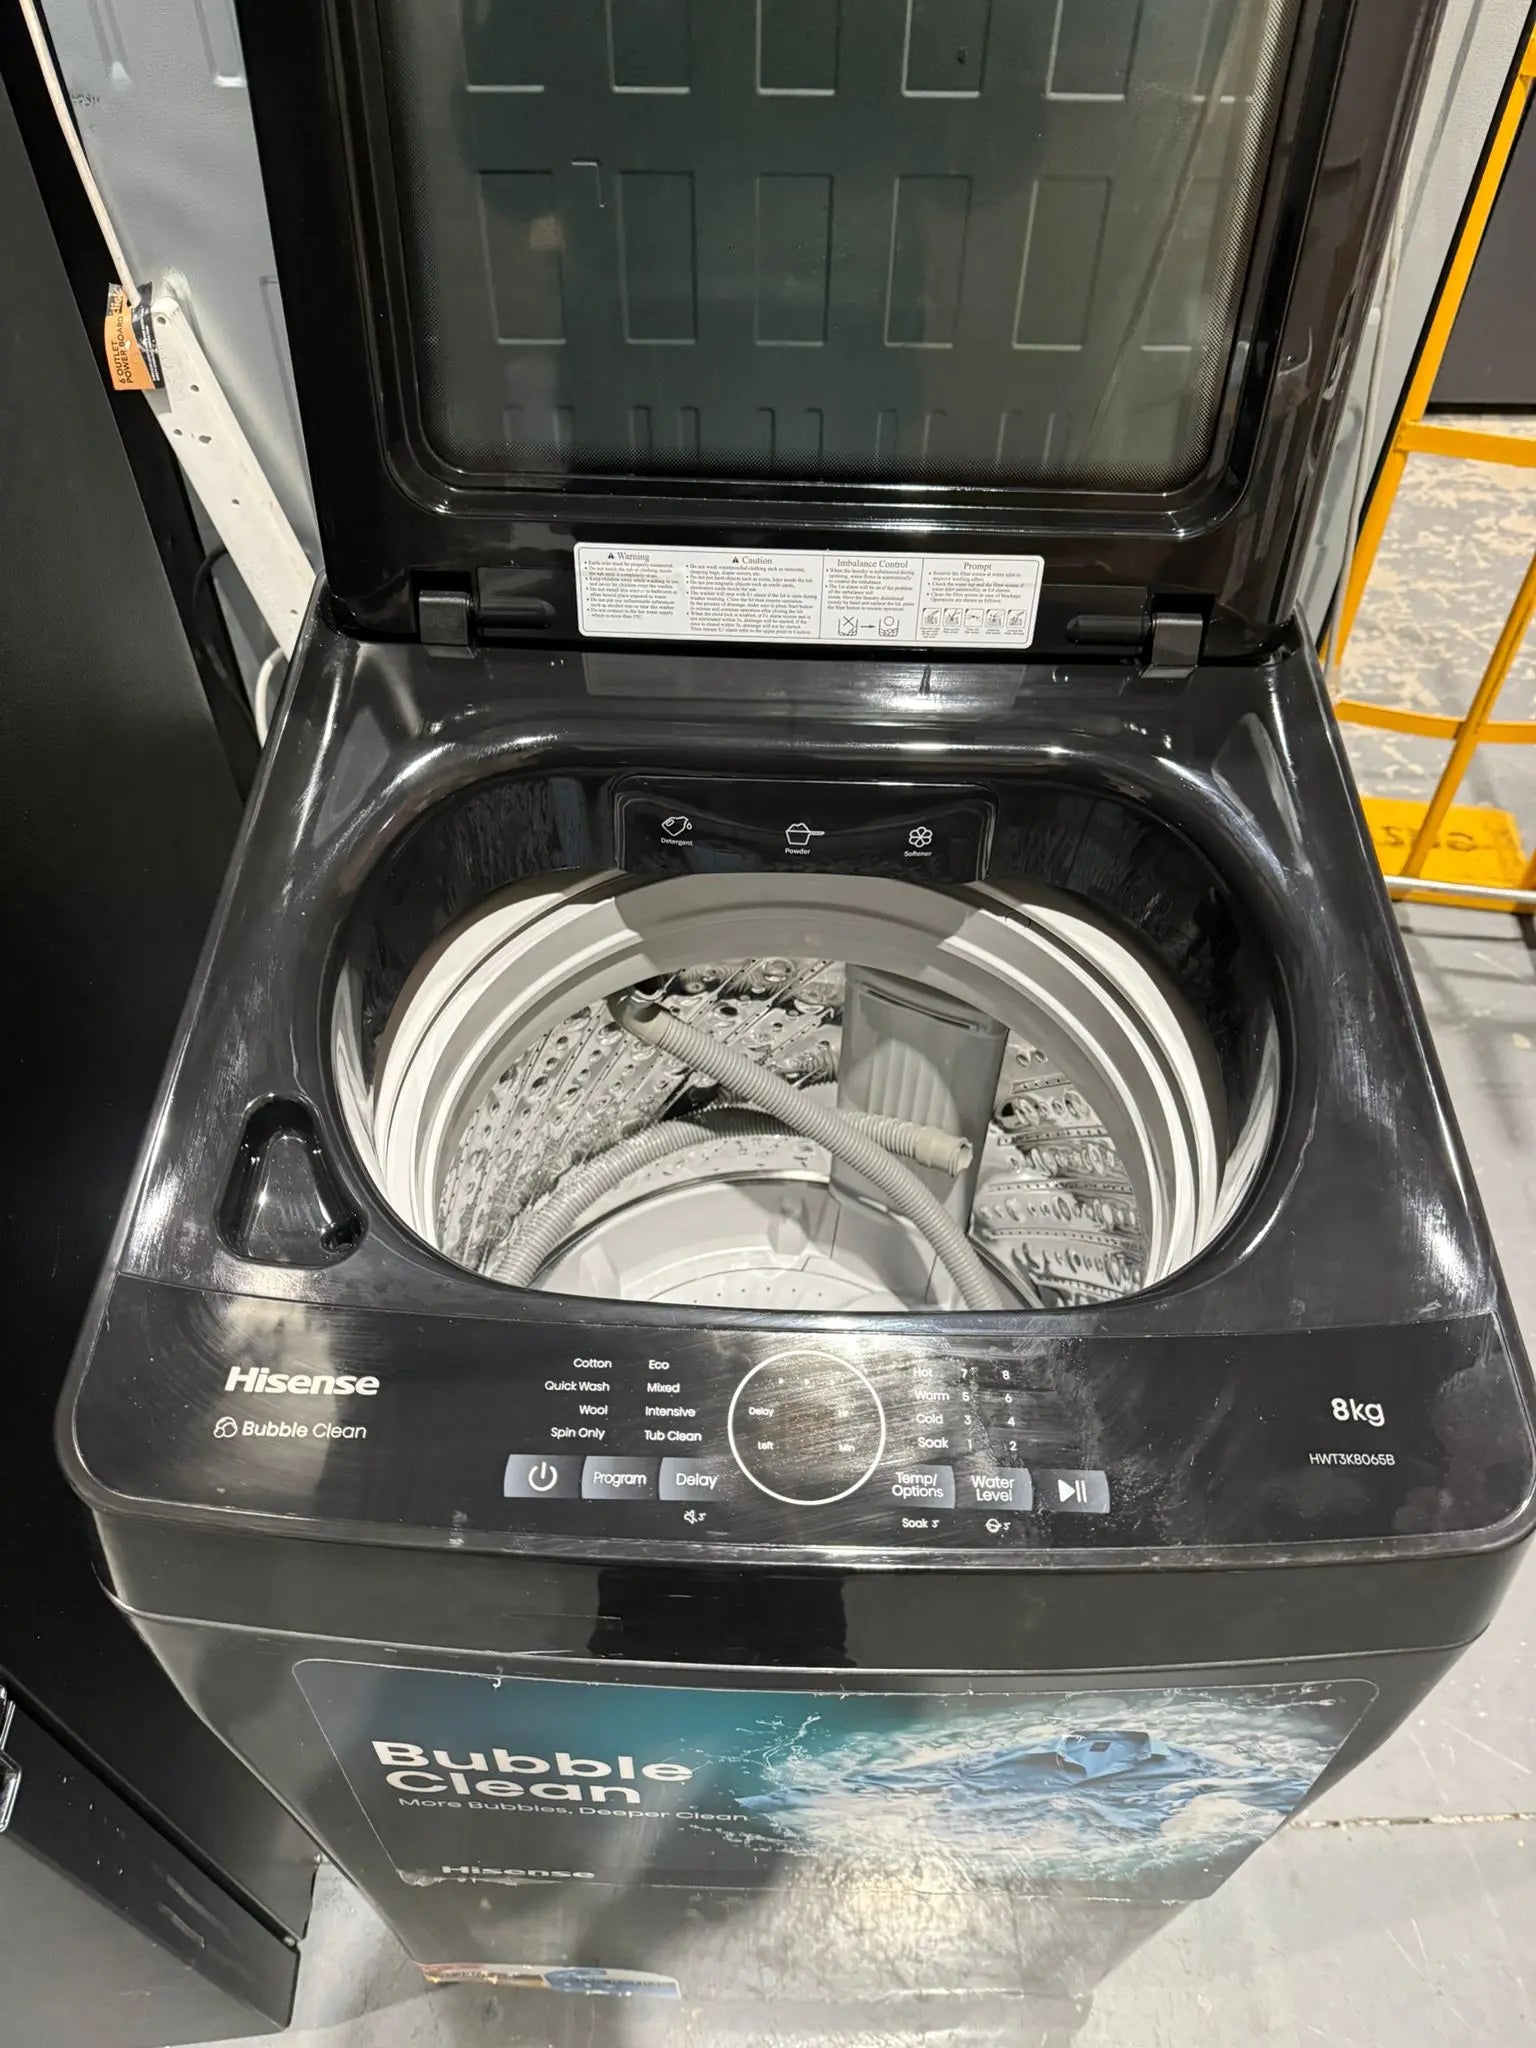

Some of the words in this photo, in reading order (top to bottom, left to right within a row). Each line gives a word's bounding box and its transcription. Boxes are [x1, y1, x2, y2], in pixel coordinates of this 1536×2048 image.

[117, 316, 126, 348] BOARD
[111, 341, 125, 376] OUTLET
[120, 349, 134, 384] POWER
[617, 552, 650, 562] Warning
[742, 556, 773, 565] Caution
[837, 559, 877, 568] Imbalance
[879, 560, 909, 569] Control
[963, 562, 992, 571] Prompt
[660, 837, 694, 847] Detergent
[785, 847, 811, 856] Powder
[904, 850, 933, 858] Softener
[573, 1358, 612, 1369] Cotton
[648, 1359, 670, 1370] Eco
[912, 1367, 933, 1378] Hot
[961, 1368, 968, 1379] 7
[1002, 1369, 1010, 1380] 8
[224, 1366, 380, 1396] Hisense
[544, 1380, 577, 1392] Quick
[578, 1380, 610, 1392] Wash
[647, 1382, 680, 1393] Mixed
[914, 1390, 950, 1401] Warm
[962, 1391, 970, 1402] 5
[1004, 1393, 1013, 1404] 6
[579, 1404, 608, 1415] Wool
[645, 1406, 696, 1417] Intensive
[748, 1406, 775, 1417] Delay
[1330, 1397, 1386, 1428] 8kg
[915, 1413, 944, 1425] Cold
[964, 1414, 972, 1426] 3
[1007, 1416, 1016, 1427] 4
[242, 1420, 309, 1438] Bubble
[312, 1422, 367, 1440] Clean
[550, 1426, 576, 1440] Spin
[578, 1427, 606, 1440] Only
[644, 1429, 665, 1441] Tub
[667, 1430, 702, 1442] Clean
[757, 1441, 775, 1450] Left
[838, 1443, 856, 1452] Min
[917, 1437, 949, 1449] Soak
[967, 1439, 972, 1450] 1
[1009, 1440, 1018, 1451] 2
[1308, 1452, 1396, 1466] HWT3K8065B
[593, 1471, 647, 1487] Program
[676, 1472, 718, 1490] Delay
[896, 1471, 938, 1487] Temp/
[971, 1474, 1016, 1489] Water
[891, 1484, 945, 1500] Options
[976, 1489, 1014, 1502] Level
[901, 1517, 928, 1528] Soak
[371, 1740, 694, 1782] Bubble
[385, 1770, 641, 1804] Clean
[398, 1797, 462, 1809] More
[579, 1806, 670, 1819] Deeper
[675, 1811, 749, 1822] Clean
[441, 1865, 596, 1879] Hisense
